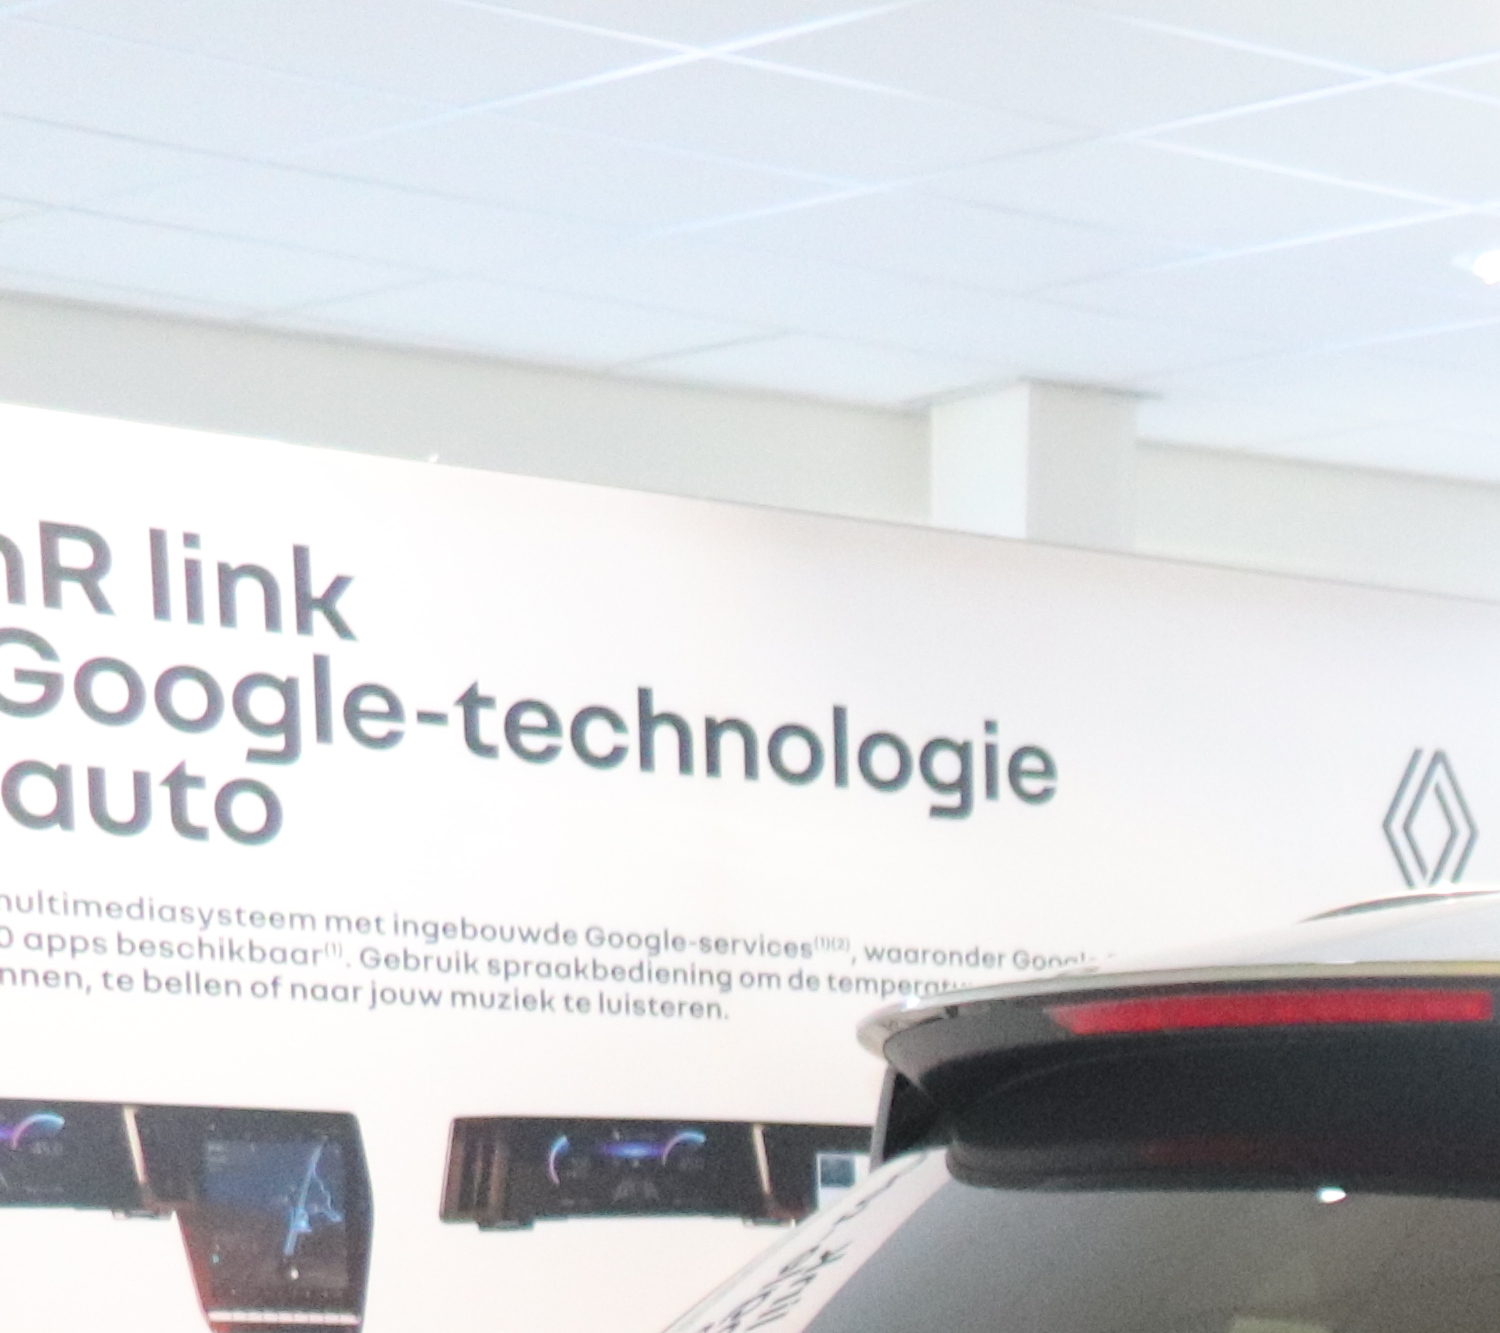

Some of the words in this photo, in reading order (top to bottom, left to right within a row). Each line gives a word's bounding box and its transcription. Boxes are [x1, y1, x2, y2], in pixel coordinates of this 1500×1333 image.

[149, 527, 358, 641] link
[0, 627, 1057, 819] Google-technologie
[1, 759, 283, 846] auto
[24, 931, 107, 959] apps
[360, 947, 479, 975] Gebruik
[487, 956, 732, 993] spraakbediening
[740, 968, 781, 991] om
[788, 968, 819, 991] de
[325, 907, 385, 934] met
[394, 913, 577, 946] ingebouwde
[863, 944, 1006, 969] waaronder
[102, 970, 134, 992] te
[144, 969, 241, 998] bellen
[250, 976, 282, 999] of
[290, 980, 363, 1002] naar
[369, 980, 442, 1010] jouw
[450, 988, 554, 1013] muziek
[563, 993, 591, 1014] te
[599, 992, 729, 1021] luisteren.
